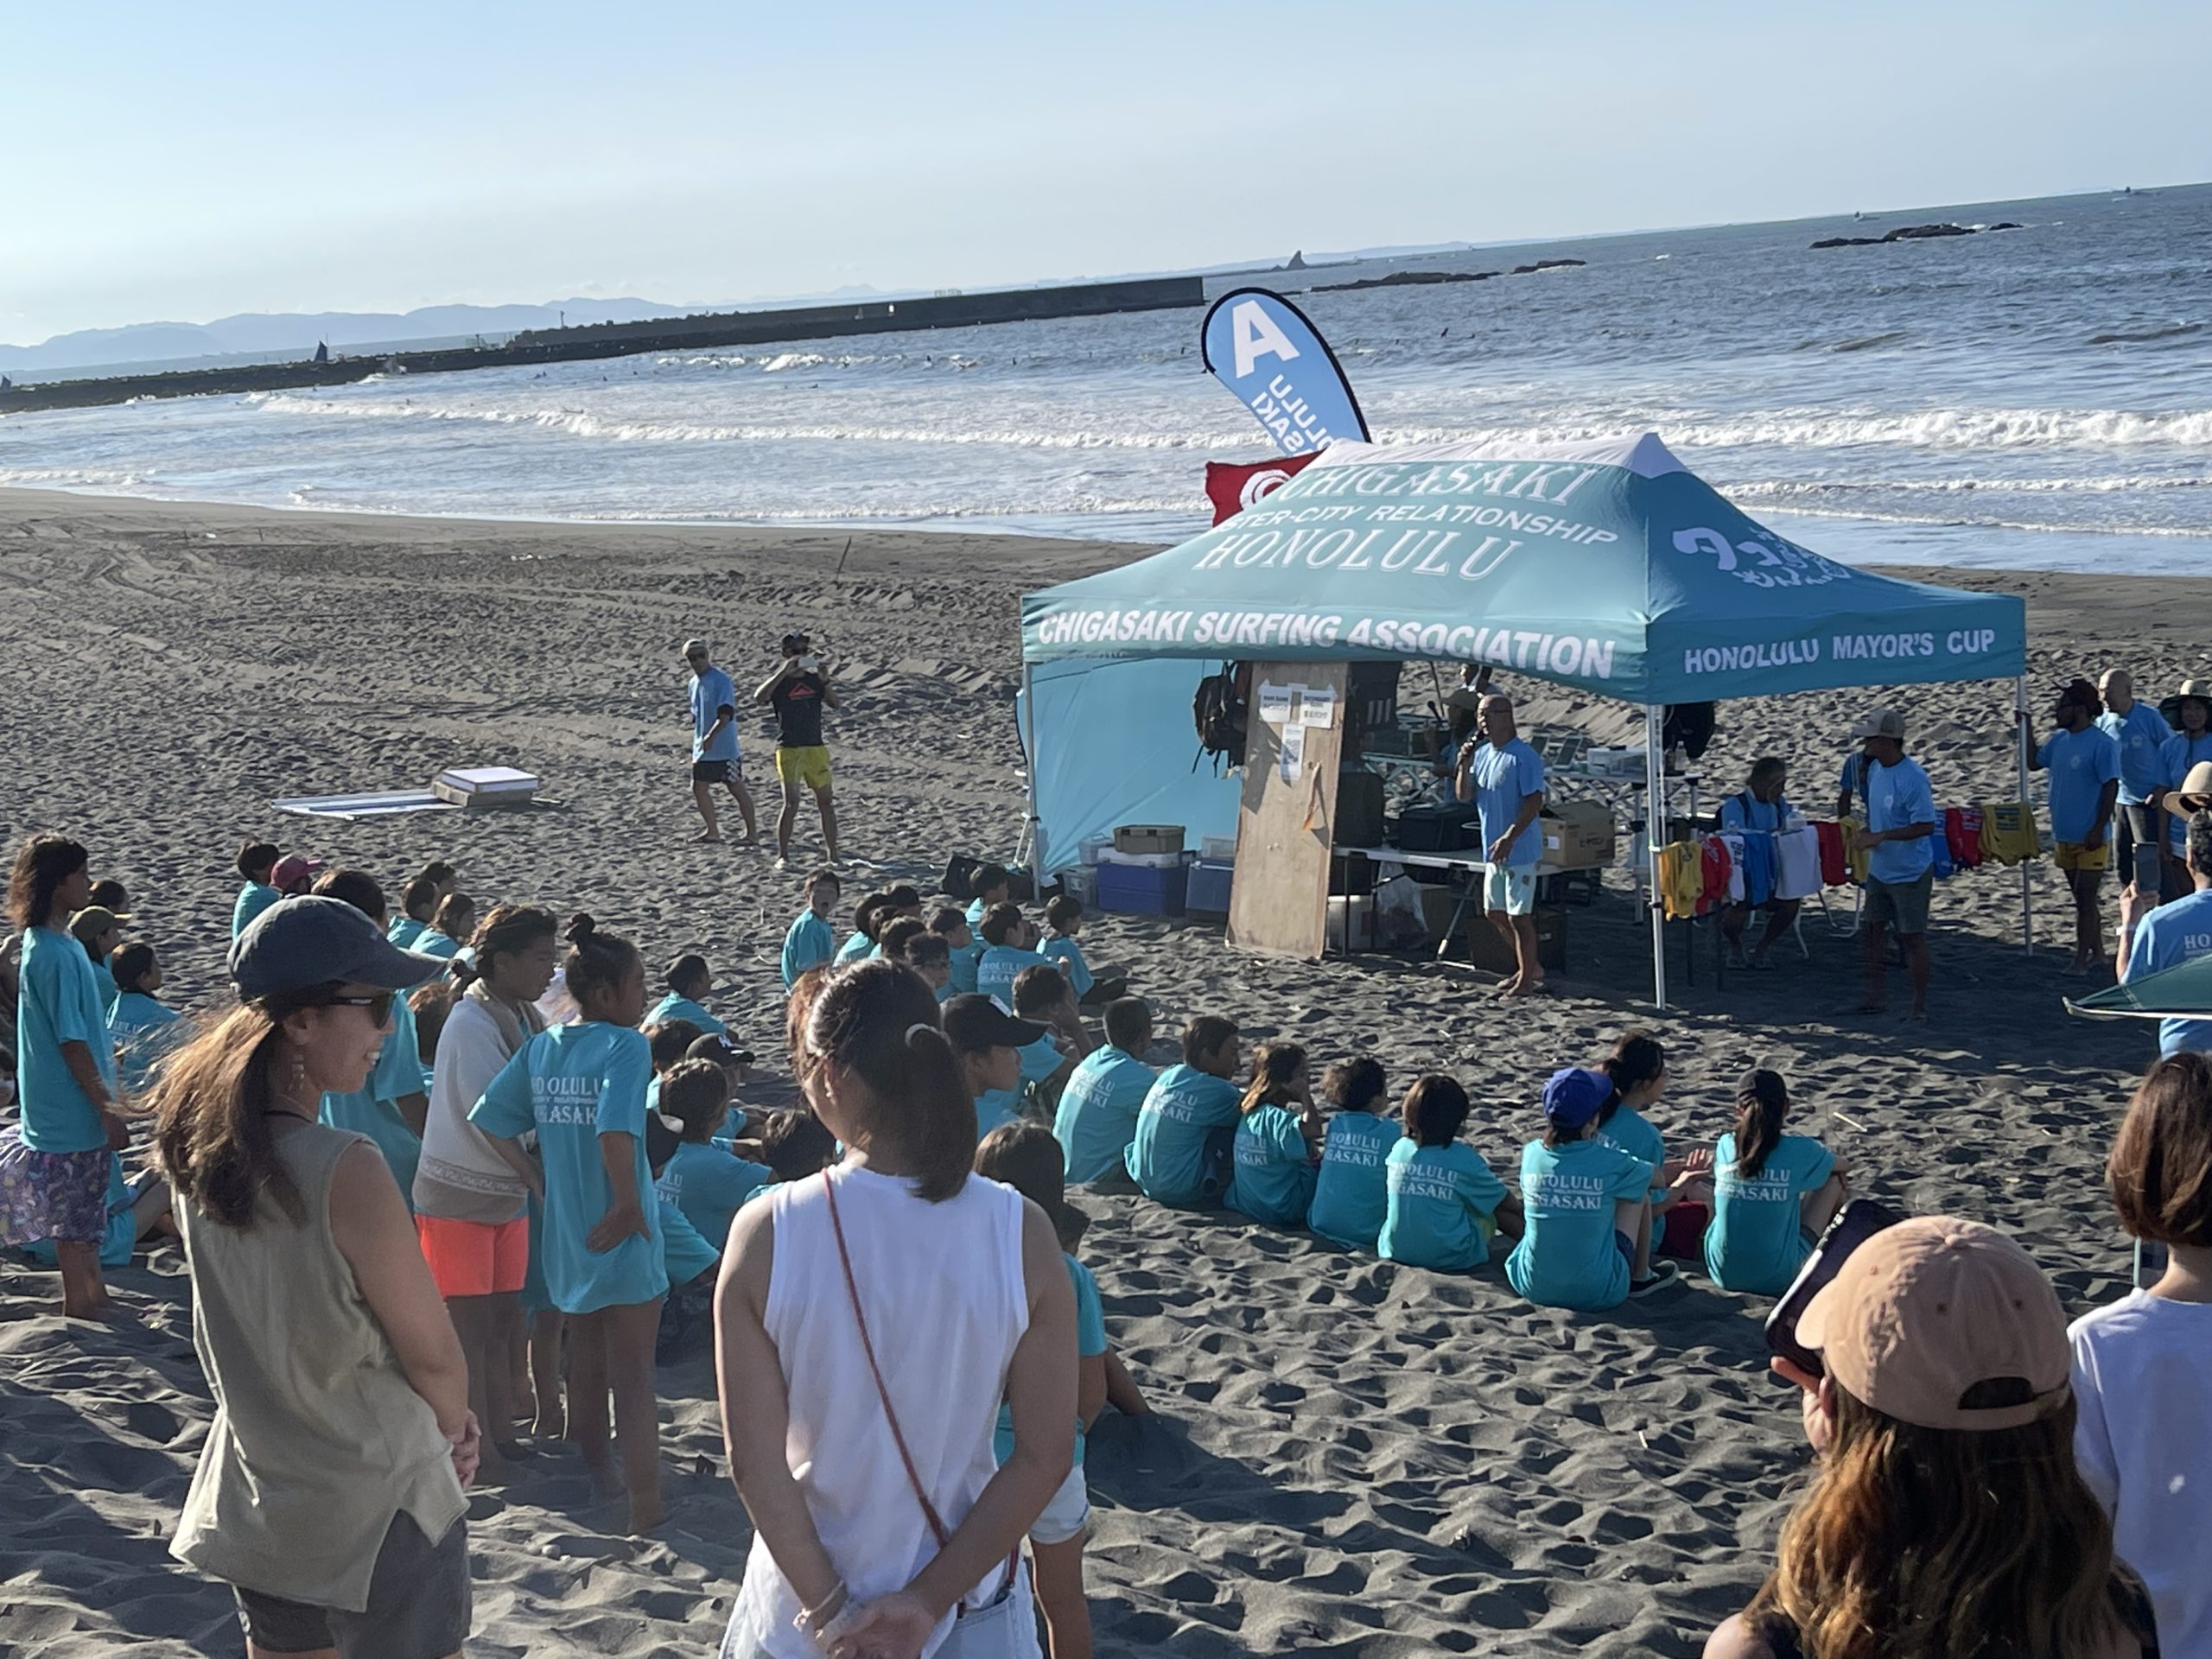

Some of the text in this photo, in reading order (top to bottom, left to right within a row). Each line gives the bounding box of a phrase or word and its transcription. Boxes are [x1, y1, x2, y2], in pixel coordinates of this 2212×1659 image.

[1232, 299, 1300, 379] A
[1214, 505, 1618, 545] STER-CITY RELATIONSHIP
[1192, 529, 1523, 582] HONOLULU
[1039, 609, 1616, 679] CHIGASAKI SURFING ASSOCIATION
[1685, 638, 1820, 674] HONOLULU
[1947, 629, 1995, 654] CUP
